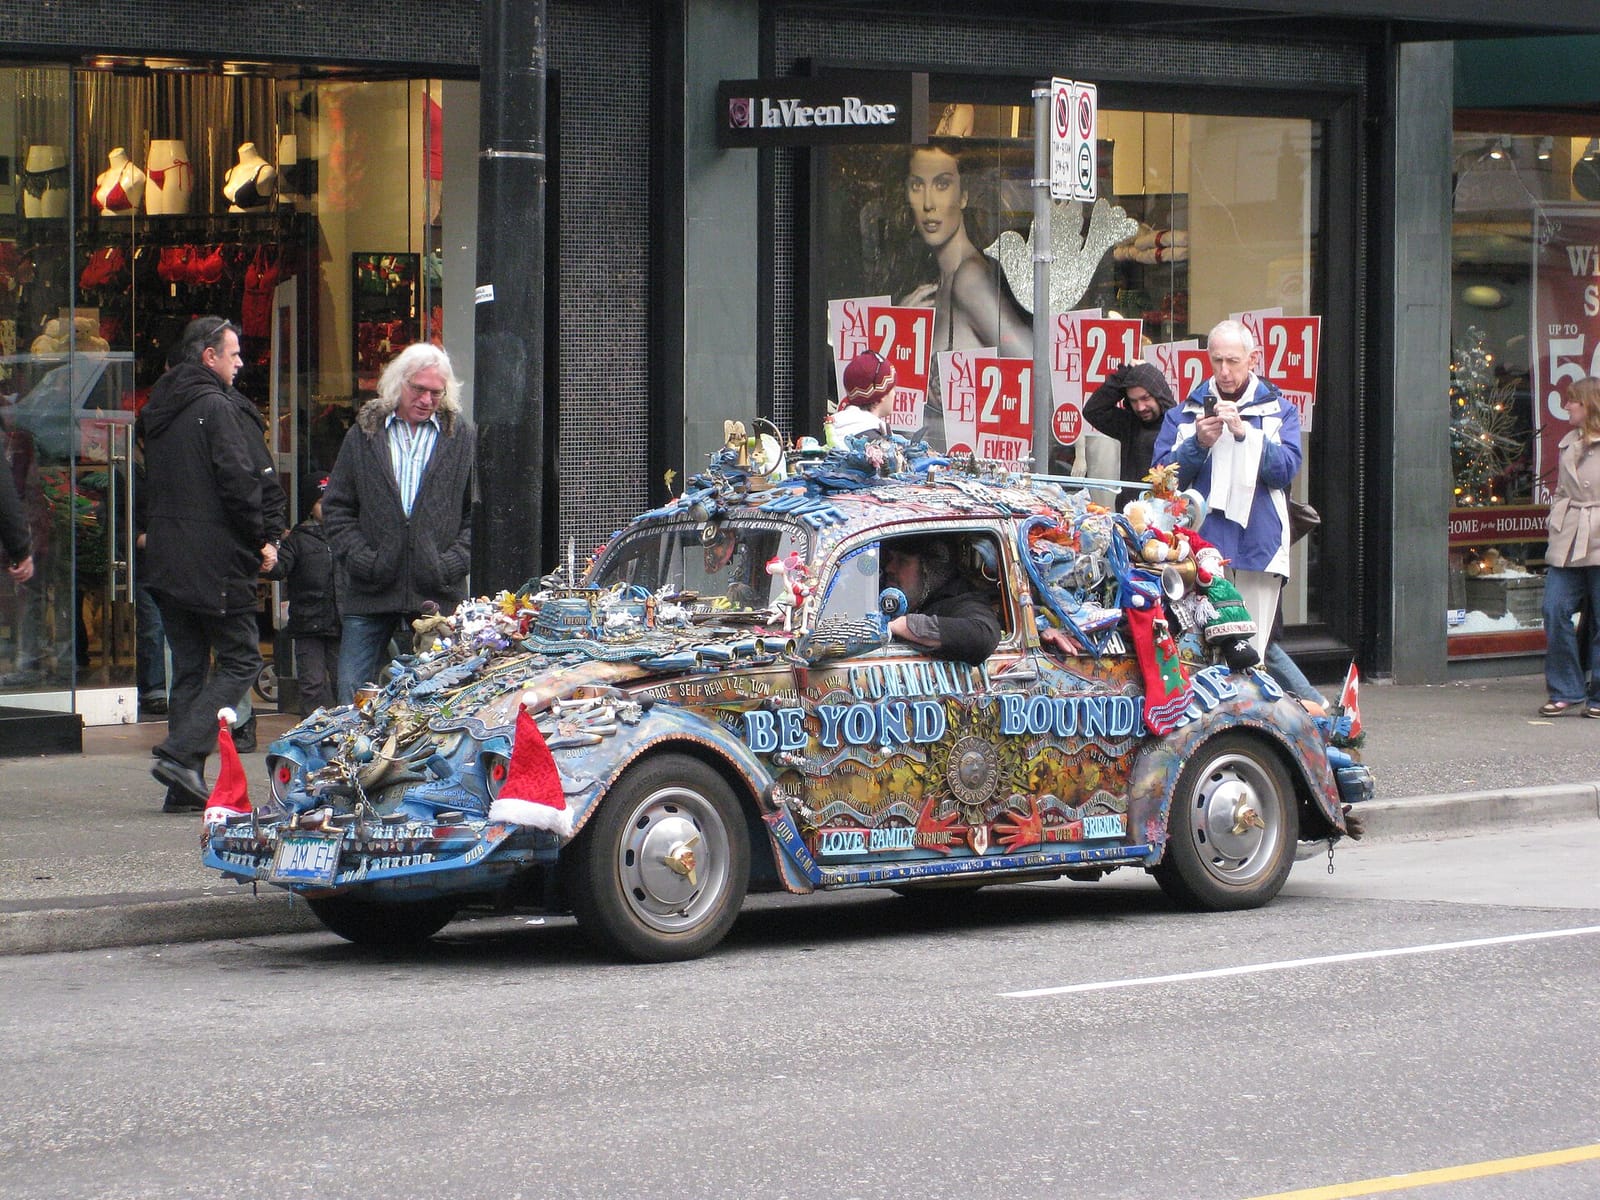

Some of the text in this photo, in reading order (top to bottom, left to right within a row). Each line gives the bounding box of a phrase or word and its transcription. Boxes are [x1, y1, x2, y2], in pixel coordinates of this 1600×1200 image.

[842, 97, 896, 124] Rose
[1548, 325, 1578, 335] UP TO
[896, 345, 912, 360] for
[912, 317, 926, 375] 1
[1086, 327, 1106, 382] 2
[1269, 325, 1313, 378] 2 for 1
[892, 391, 917, 413] ERY
[981, 366, 1031, 424] 2 for 1
[886, 412, 917, 426] HING!
[1057, 411, 1078, 422] 3 DAYS
[1060, 421, 1075, 433] ONLY
[983, 440, 1022, 460] EVERY
[1496, 516, 1548, 532] HOLIDAY
[680, 683, 702, 697] SELF
[849, 663, 994, 699] COMMUNITY
[776, 821, 794, 844] OUR
[1083, 815, 1122, 838] FRIENDS
[821, 825, 917, 852] LOVE FAMILY
[291, 845, 310, 870] AM
[464, 844, 485, 865] OUR
